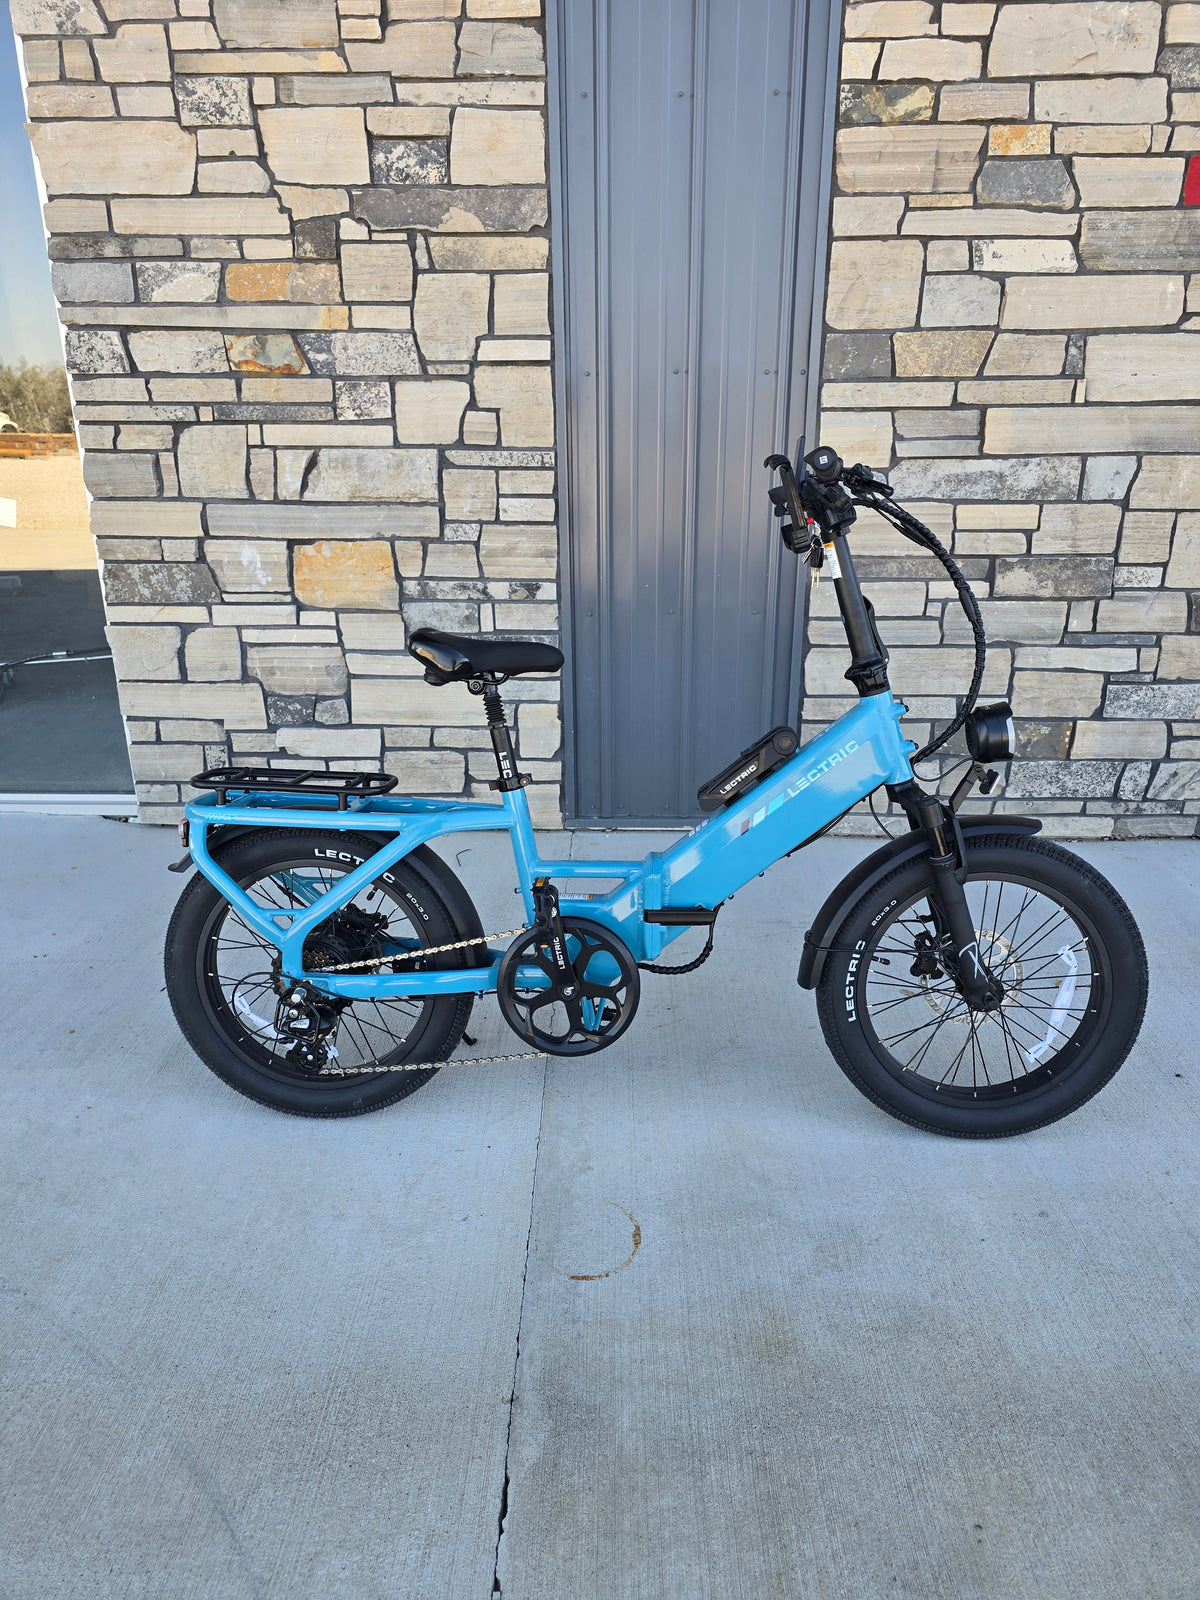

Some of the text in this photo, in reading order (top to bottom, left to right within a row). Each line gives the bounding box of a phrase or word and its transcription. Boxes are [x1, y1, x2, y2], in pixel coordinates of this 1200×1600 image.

[719, 764, 758, 795] LECTRIC
[786, 739, 860, 799] LECTRIC
[314, 848, 396, 884] LECTC
[553, 936, 566, 969] LECTRIC
[845, 939, 867, 1023] LECTRIC
